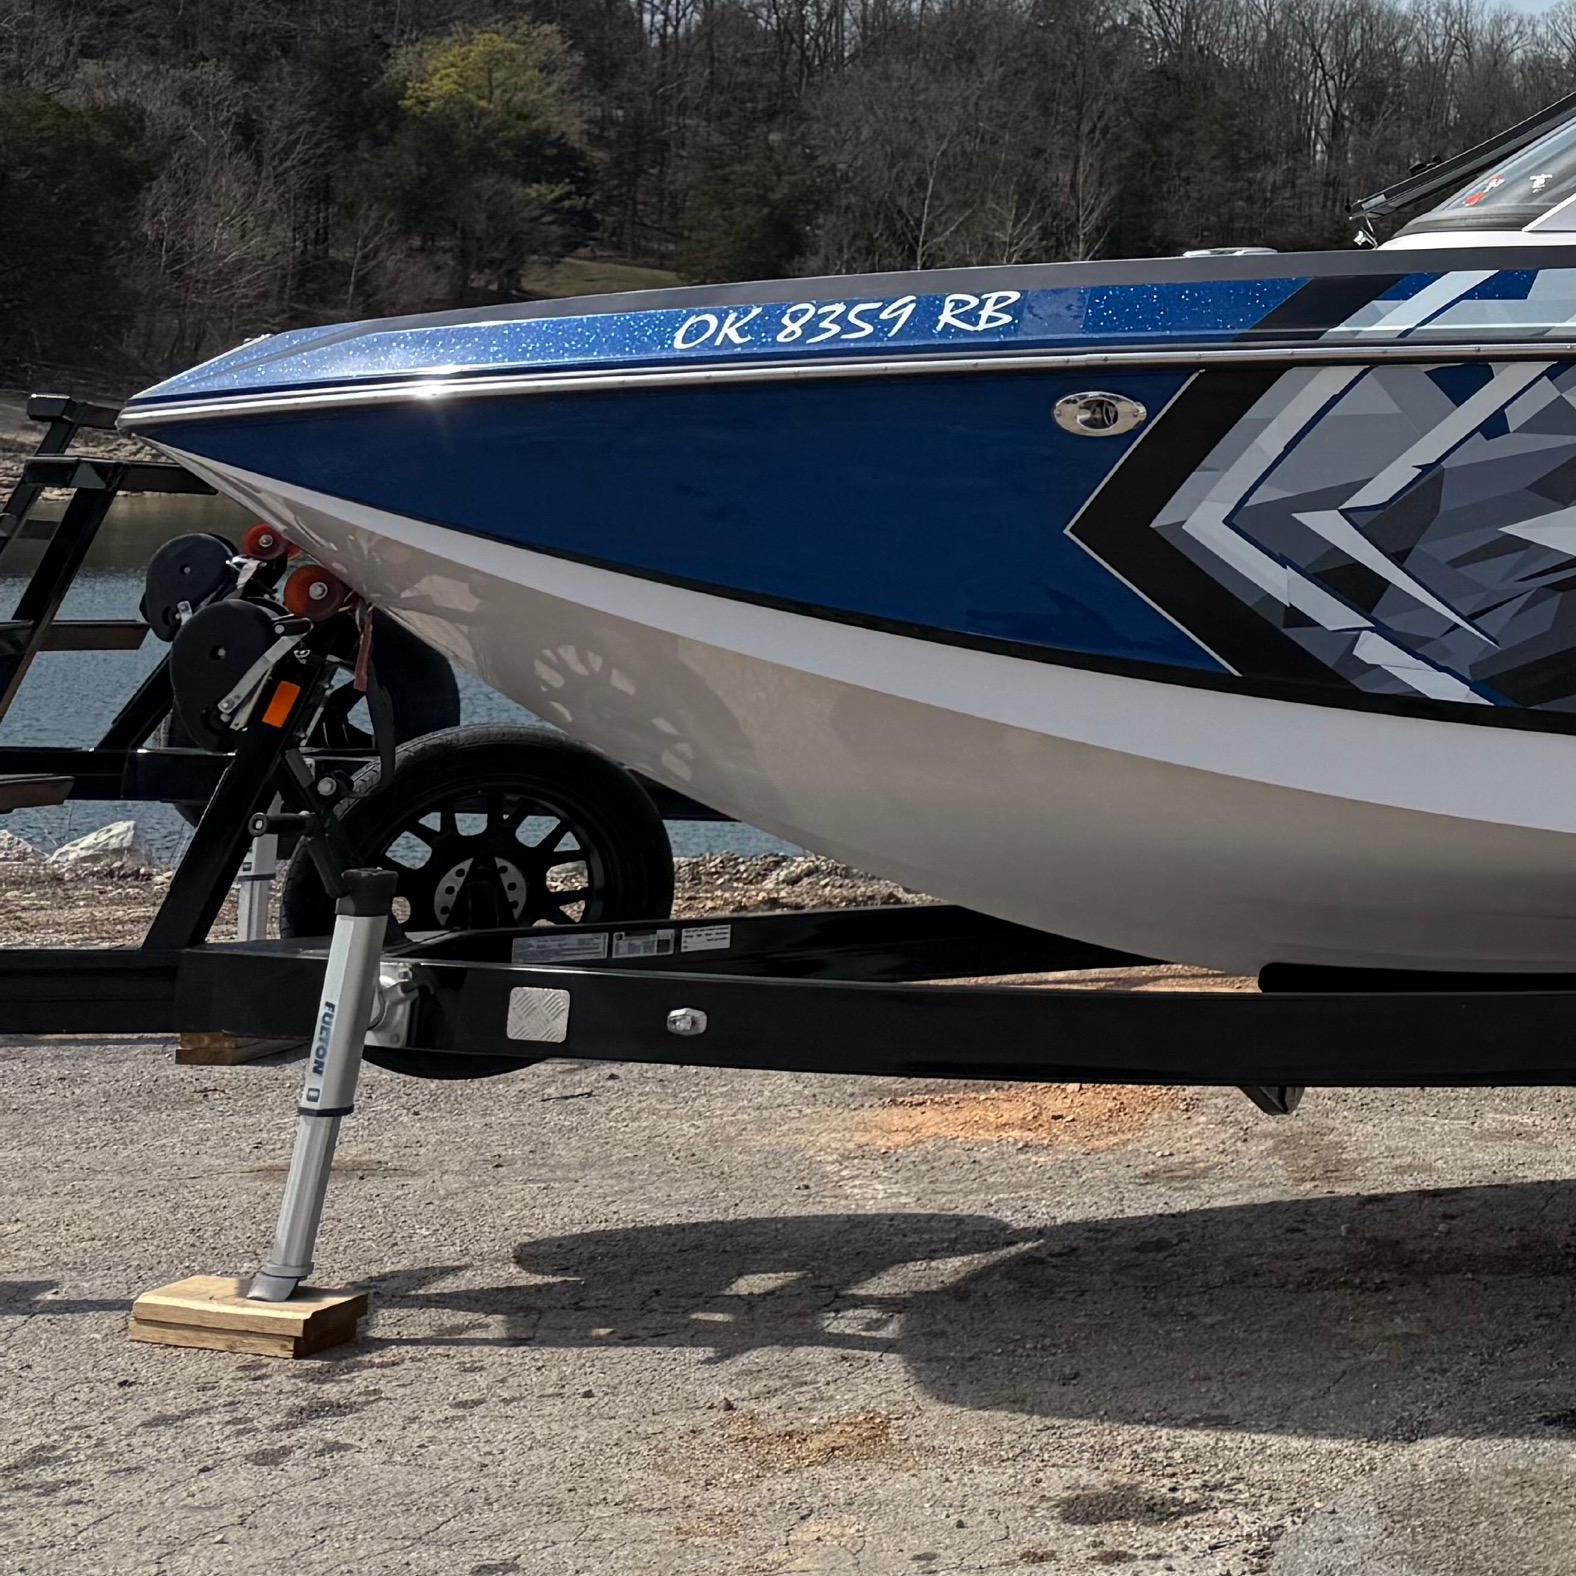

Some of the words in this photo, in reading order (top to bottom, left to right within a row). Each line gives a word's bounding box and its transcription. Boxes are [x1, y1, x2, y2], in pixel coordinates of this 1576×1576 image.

[672, 306, 763, 350] OK
[775, 294, 917, 345] 8359
[934, 290, 1021, 333] RB
